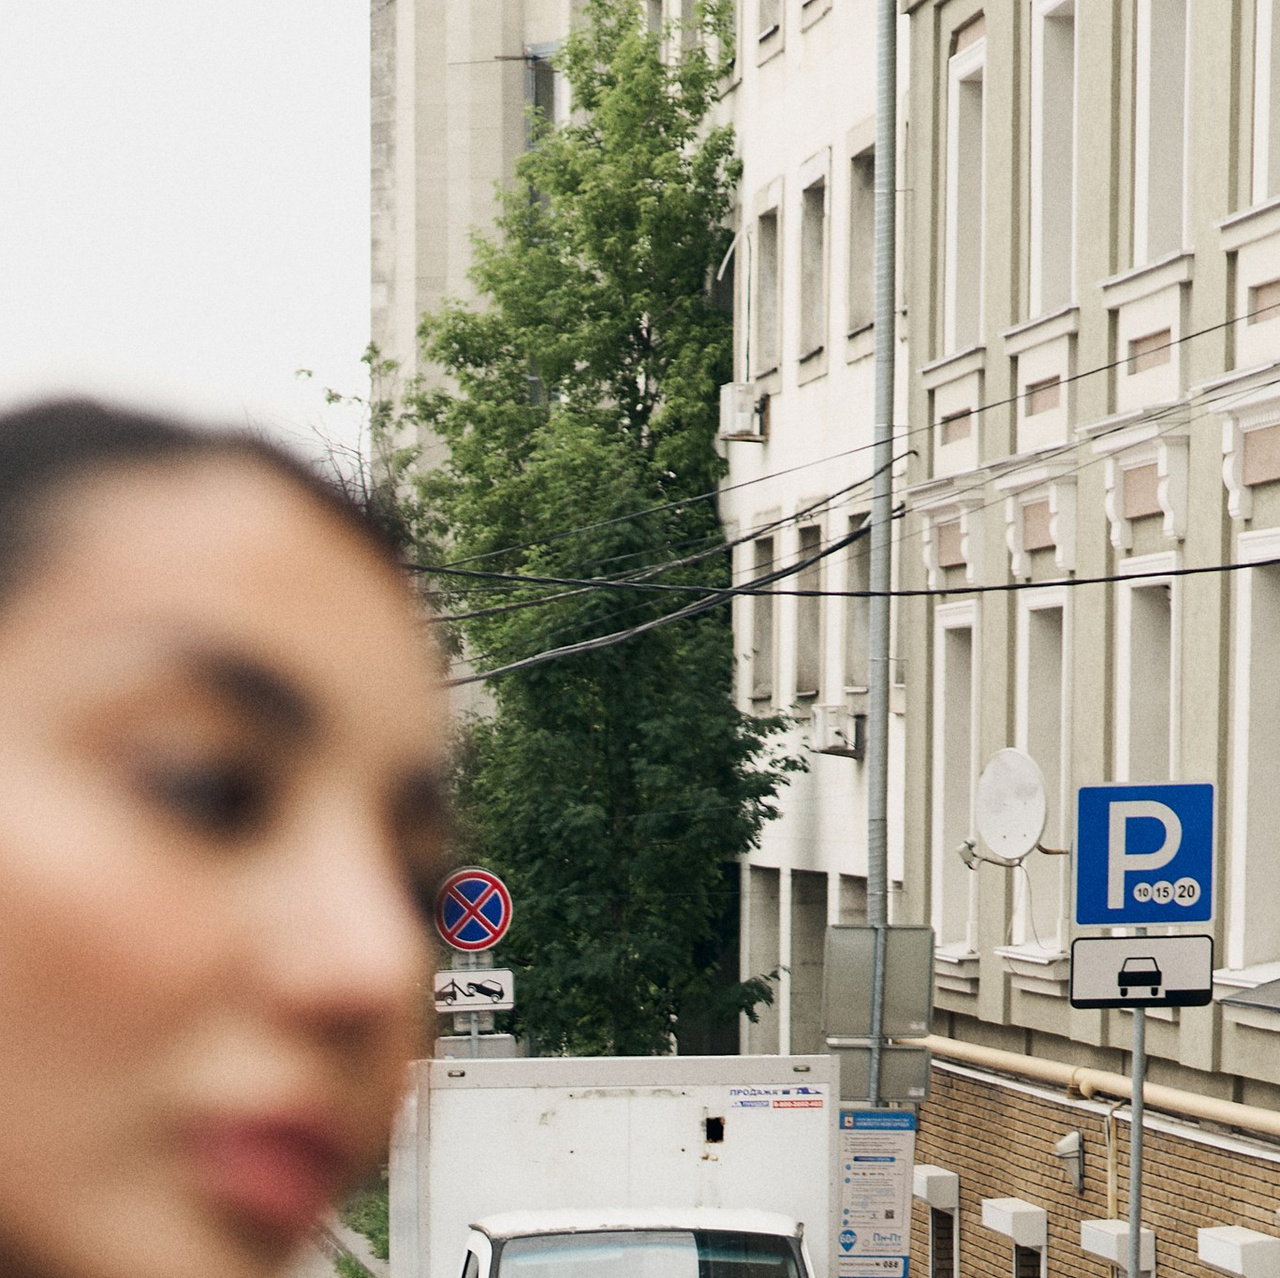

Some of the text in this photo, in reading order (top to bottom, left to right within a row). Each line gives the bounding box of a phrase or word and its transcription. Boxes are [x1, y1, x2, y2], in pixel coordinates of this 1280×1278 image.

[1107, 800, 1183, 910] P
[1138, 884, 1195, 898] 10 15 20
